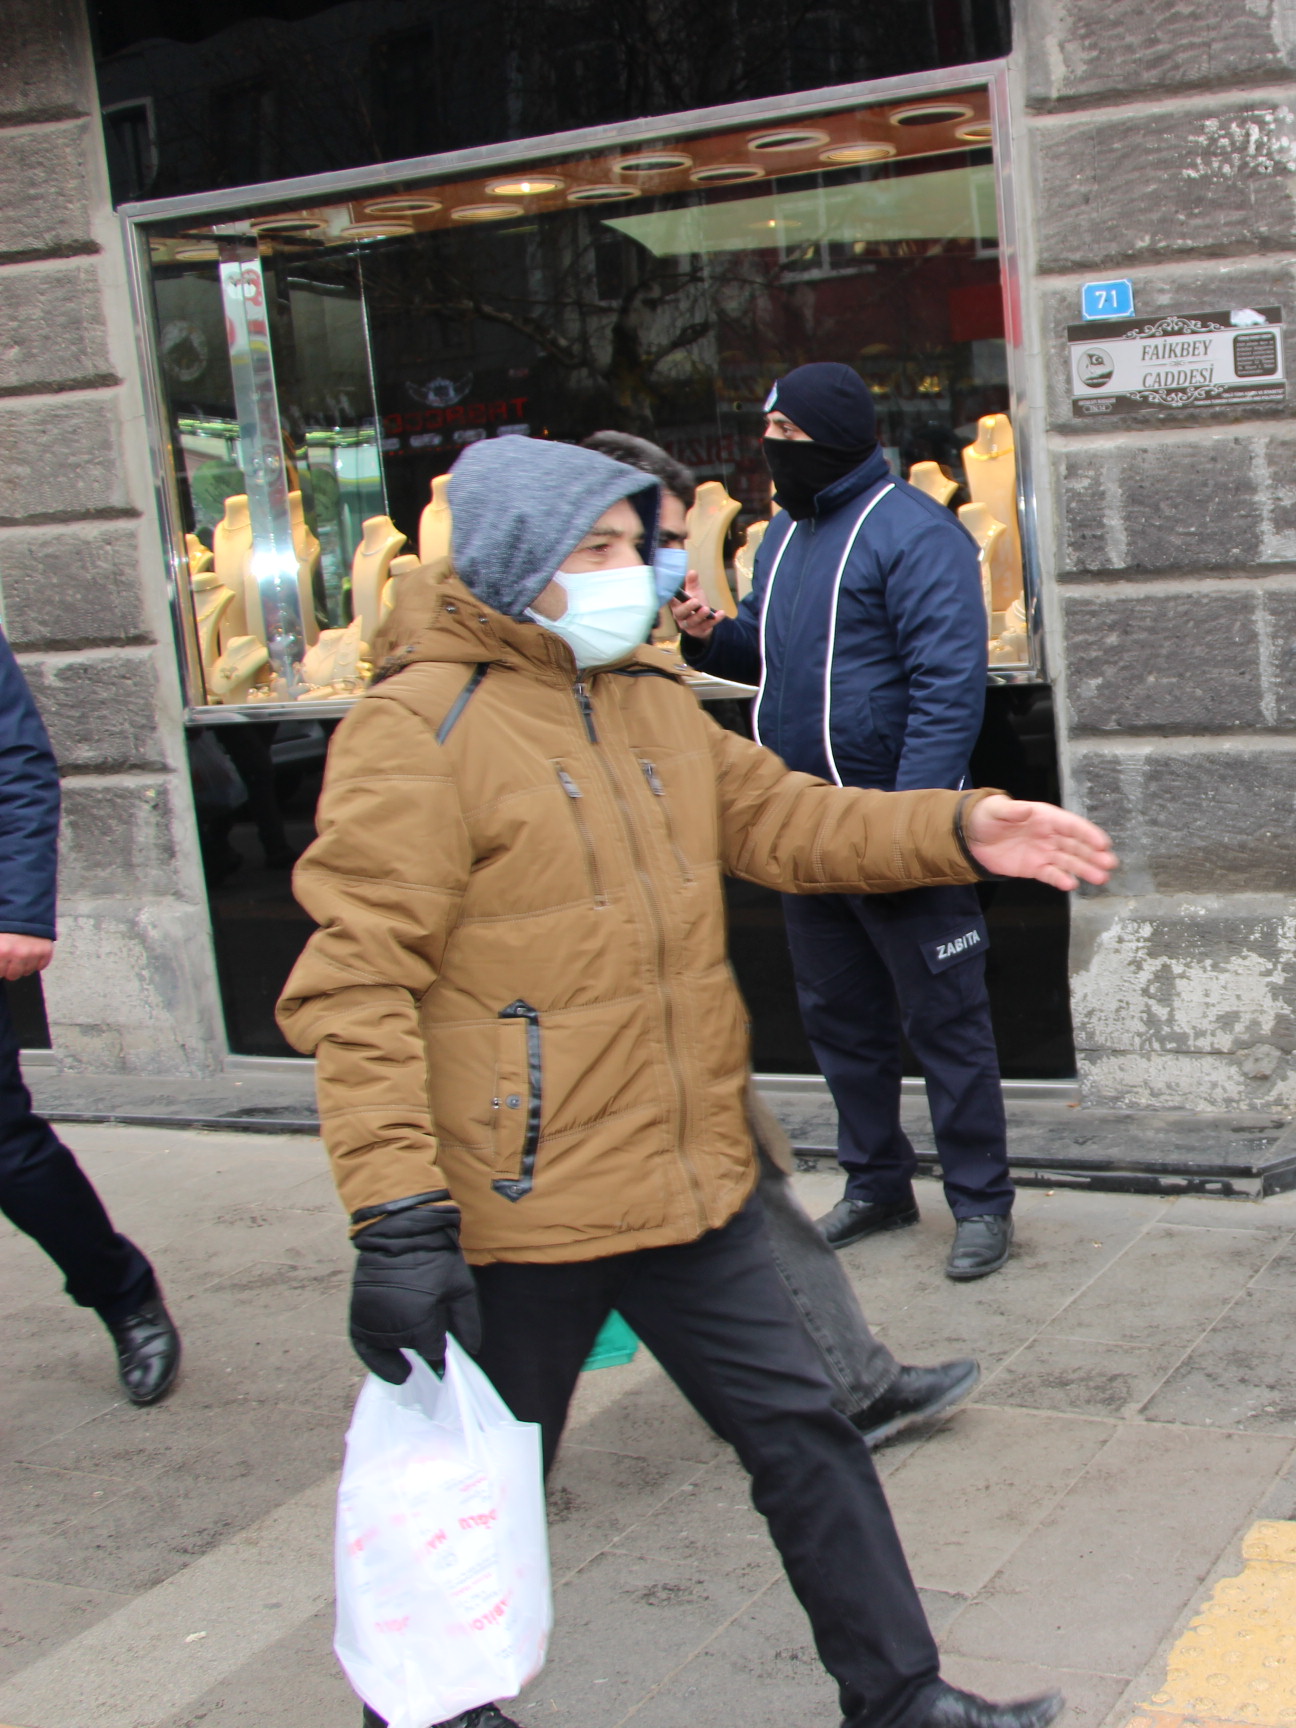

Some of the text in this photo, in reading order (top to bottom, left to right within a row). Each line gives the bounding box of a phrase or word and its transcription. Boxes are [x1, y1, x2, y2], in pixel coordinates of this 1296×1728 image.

[1094, 289, 1118, 310] 71
[1141, 338, 1213, 361] FAİKBEY
[1142, 363, 1215, 388] CADDESİ
[936, 929, 981, 960] ZABITA
